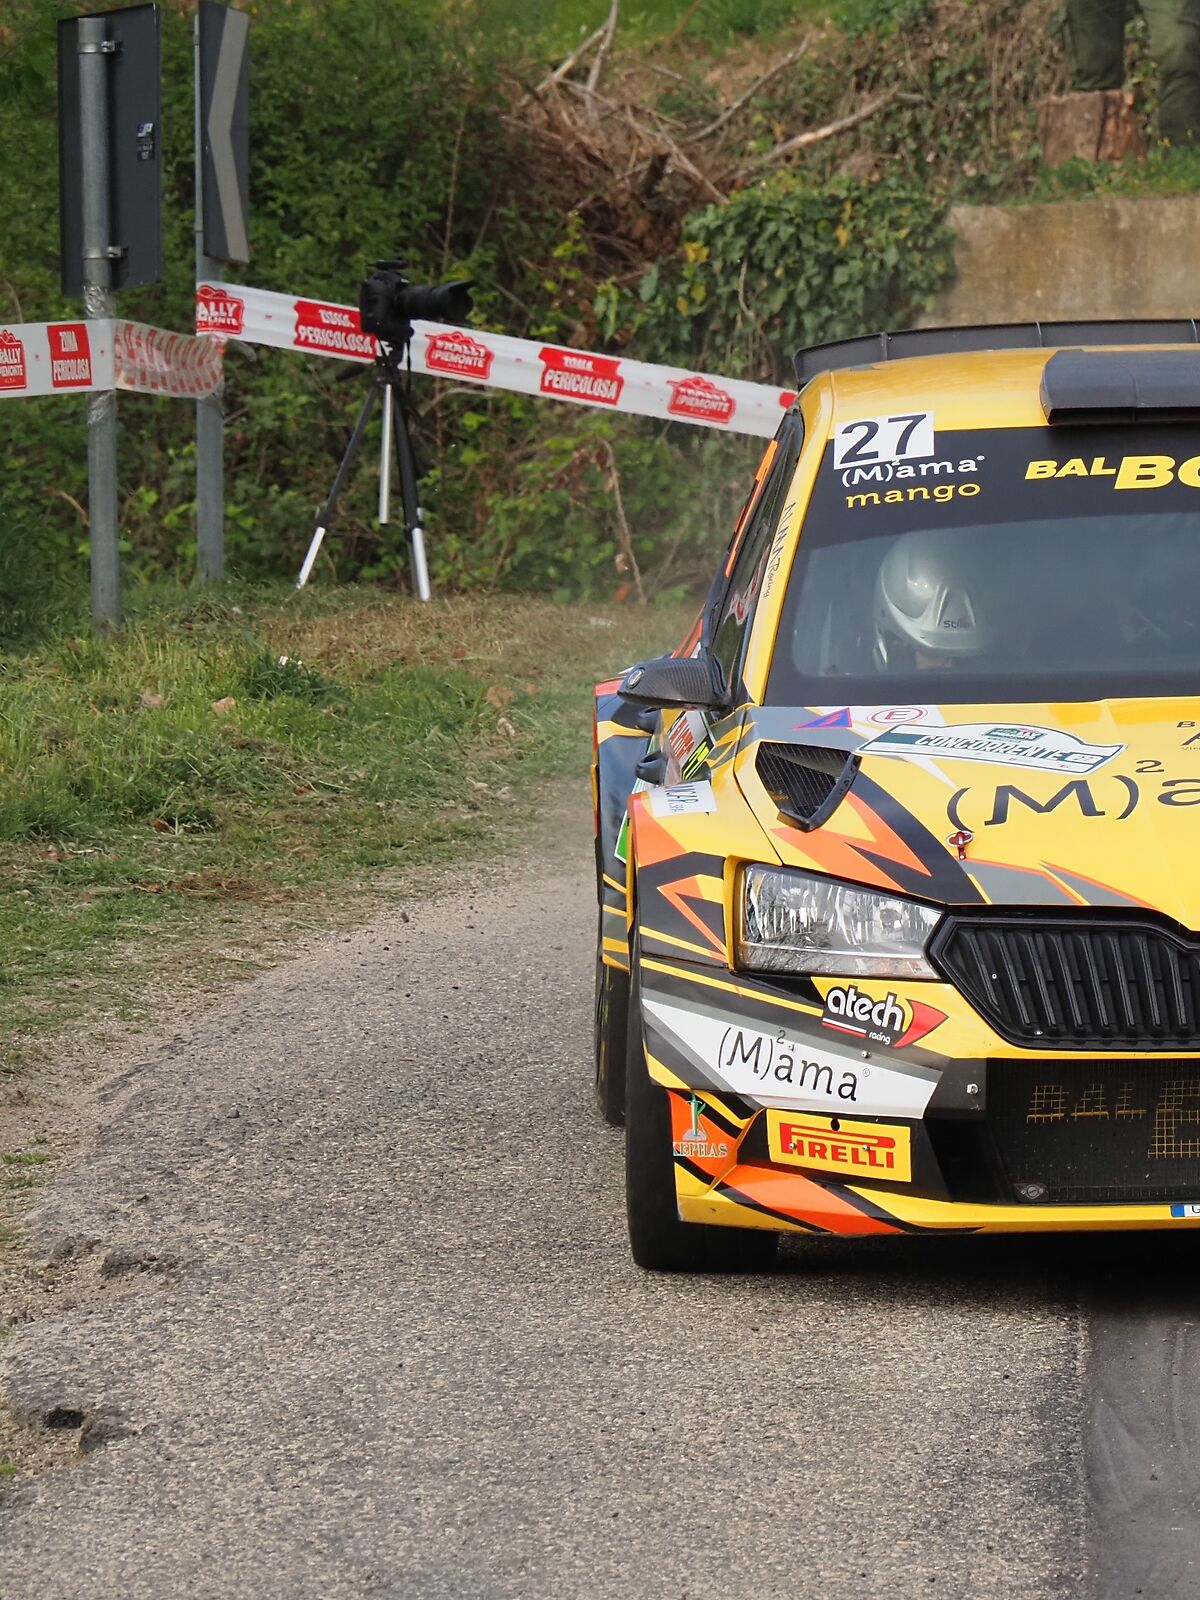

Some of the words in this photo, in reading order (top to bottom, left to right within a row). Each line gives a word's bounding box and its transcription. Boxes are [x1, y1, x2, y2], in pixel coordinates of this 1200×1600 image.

[196, 302, 237, 320] ALLY
[53, 359, 90, 380] PERICOLOSA
[544, 369, 618, 400] PERICOLOSA
[839, 413, 927, 465] 27
[846, 482, 981, 509] mango
[914, 734, 1070, 762] CONCORRENTE
[827, 987, 904, 1032] atech
[868, 1031, 891, 1046] racing
[779, 1123, 896, 1169] PIRELLI
